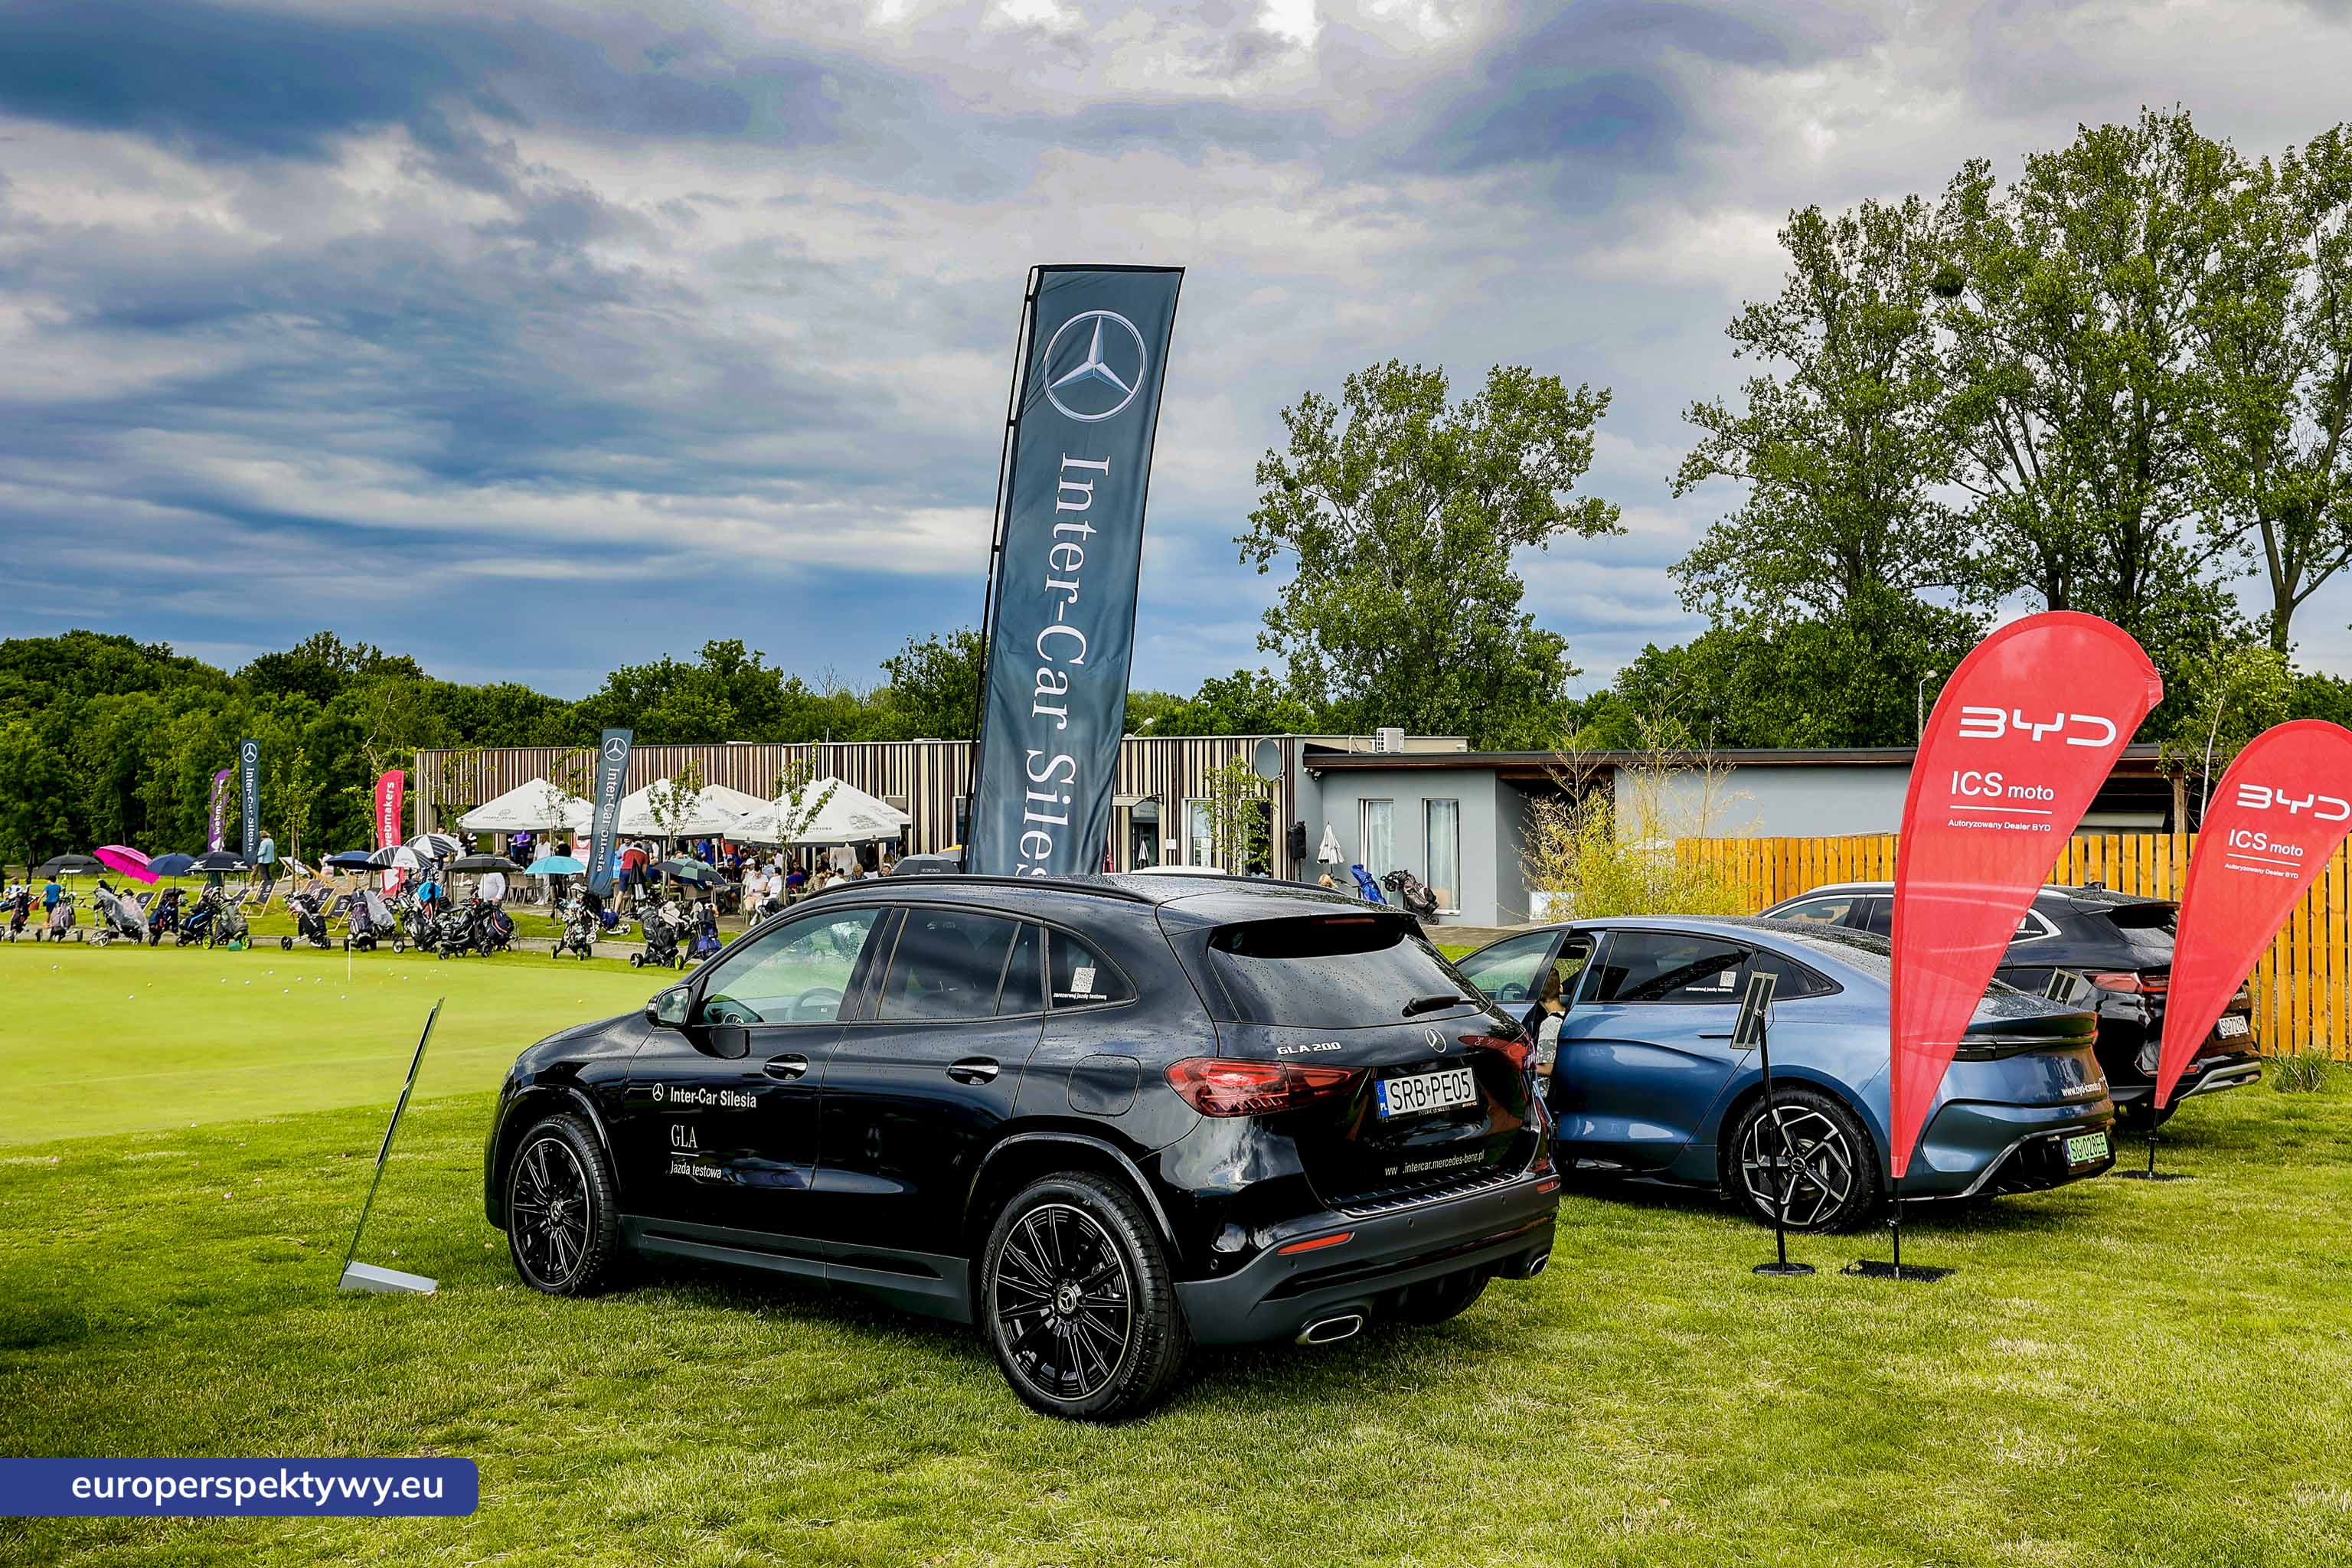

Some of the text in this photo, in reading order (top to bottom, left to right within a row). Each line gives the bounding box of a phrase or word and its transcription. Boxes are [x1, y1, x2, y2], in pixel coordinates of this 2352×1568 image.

[1031, 452, 1111, 731] Inter-Car
[1959, 706, 2117, 747] BYD
[602, 767, 620, 825] Inter-Car
[1952, 770, 2055, 801] ICS moto
[2236, 783, 2351, 822] BYD
[1948, 818, 2051, 832] Autoryzowany Dealer BYD
[2228, 828, 2304, 857] ICS moto
[2224, 863, 2265, 874] Autoryzowany
[2265, 868, 2285, 877] Dealer
[1276, 1041, 1342, 1055] GLA 200
[670, 1086, 757, 1109] Inter-Car Silesia
[1390, 1077, 1426, 1111] SRB
[1430, 1071, 1472, 1105] PE05
[671, 1124, 698, 1148] GLA
[2069, 1134, 2107, 1160] SG 028EE
[670, 1160, 722, 1179] Jazda testowa
